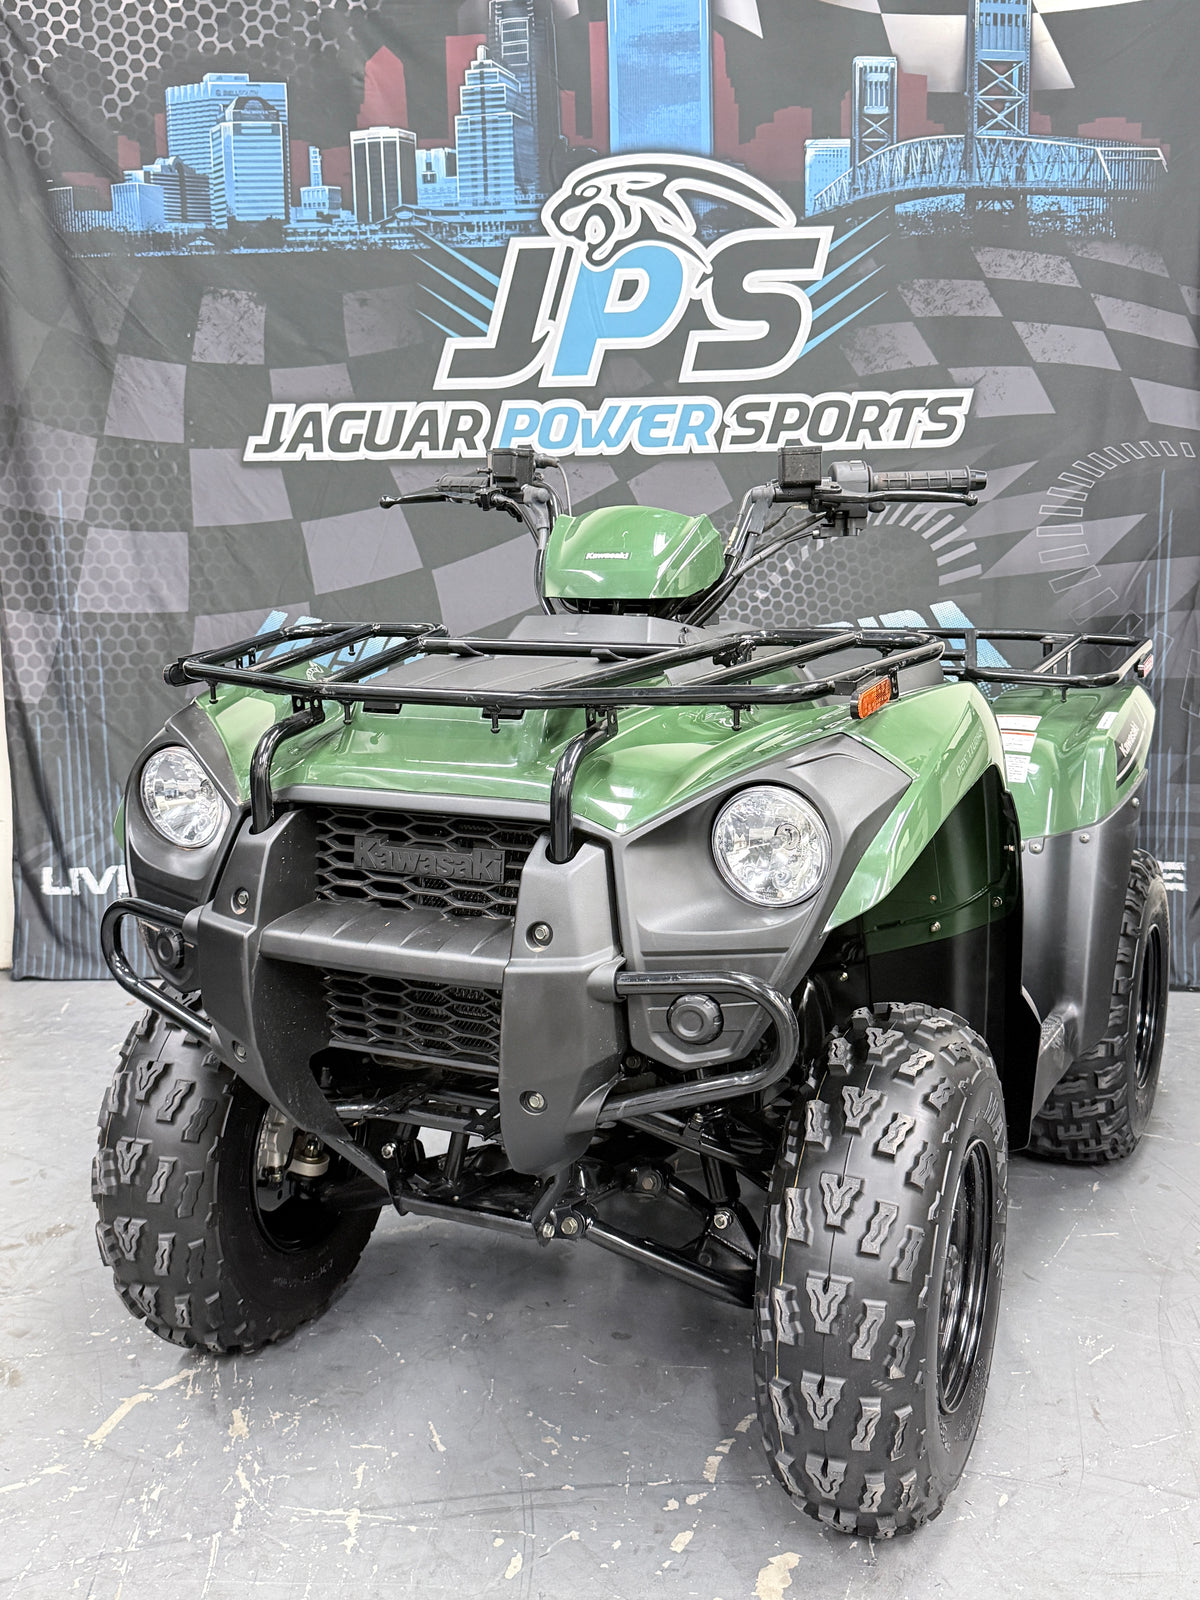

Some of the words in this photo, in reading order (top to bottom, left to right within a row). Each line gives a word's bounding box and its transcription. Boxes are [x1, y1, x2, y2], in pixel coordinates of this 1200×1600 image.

[437, 228, 831, 387] JPS
[247, 404, 488, 458] JAGUAR
[495, 400, 716, 454] POWER
[726, 392, 970, 449] SPORTS
[353, 834, 505, 884] Kawasaki
